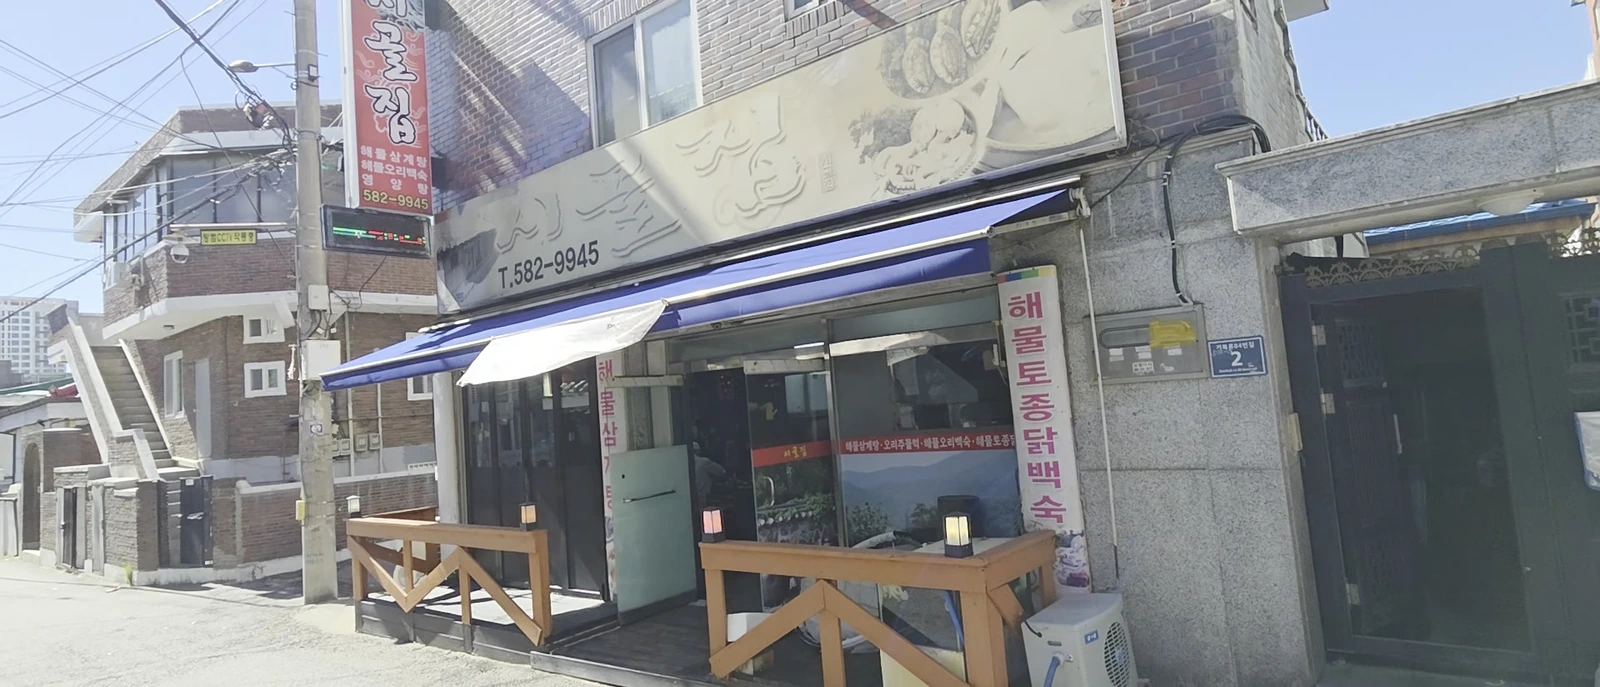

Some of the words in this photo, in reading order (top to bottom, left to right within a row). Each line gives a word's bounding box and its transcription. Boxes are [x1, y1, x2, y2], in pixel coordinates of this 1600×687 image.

[364, 0, 418, 144] 골집
[361, 159, 428, 181] 해물오리백숙
[363, 189, 429, 210] 582-9945
[498, 240, 600, 289] T.582-9945
[1231, 350, 1243, 367] 2
[1007, 291, 1067, 524] 해물토종닭백숙
